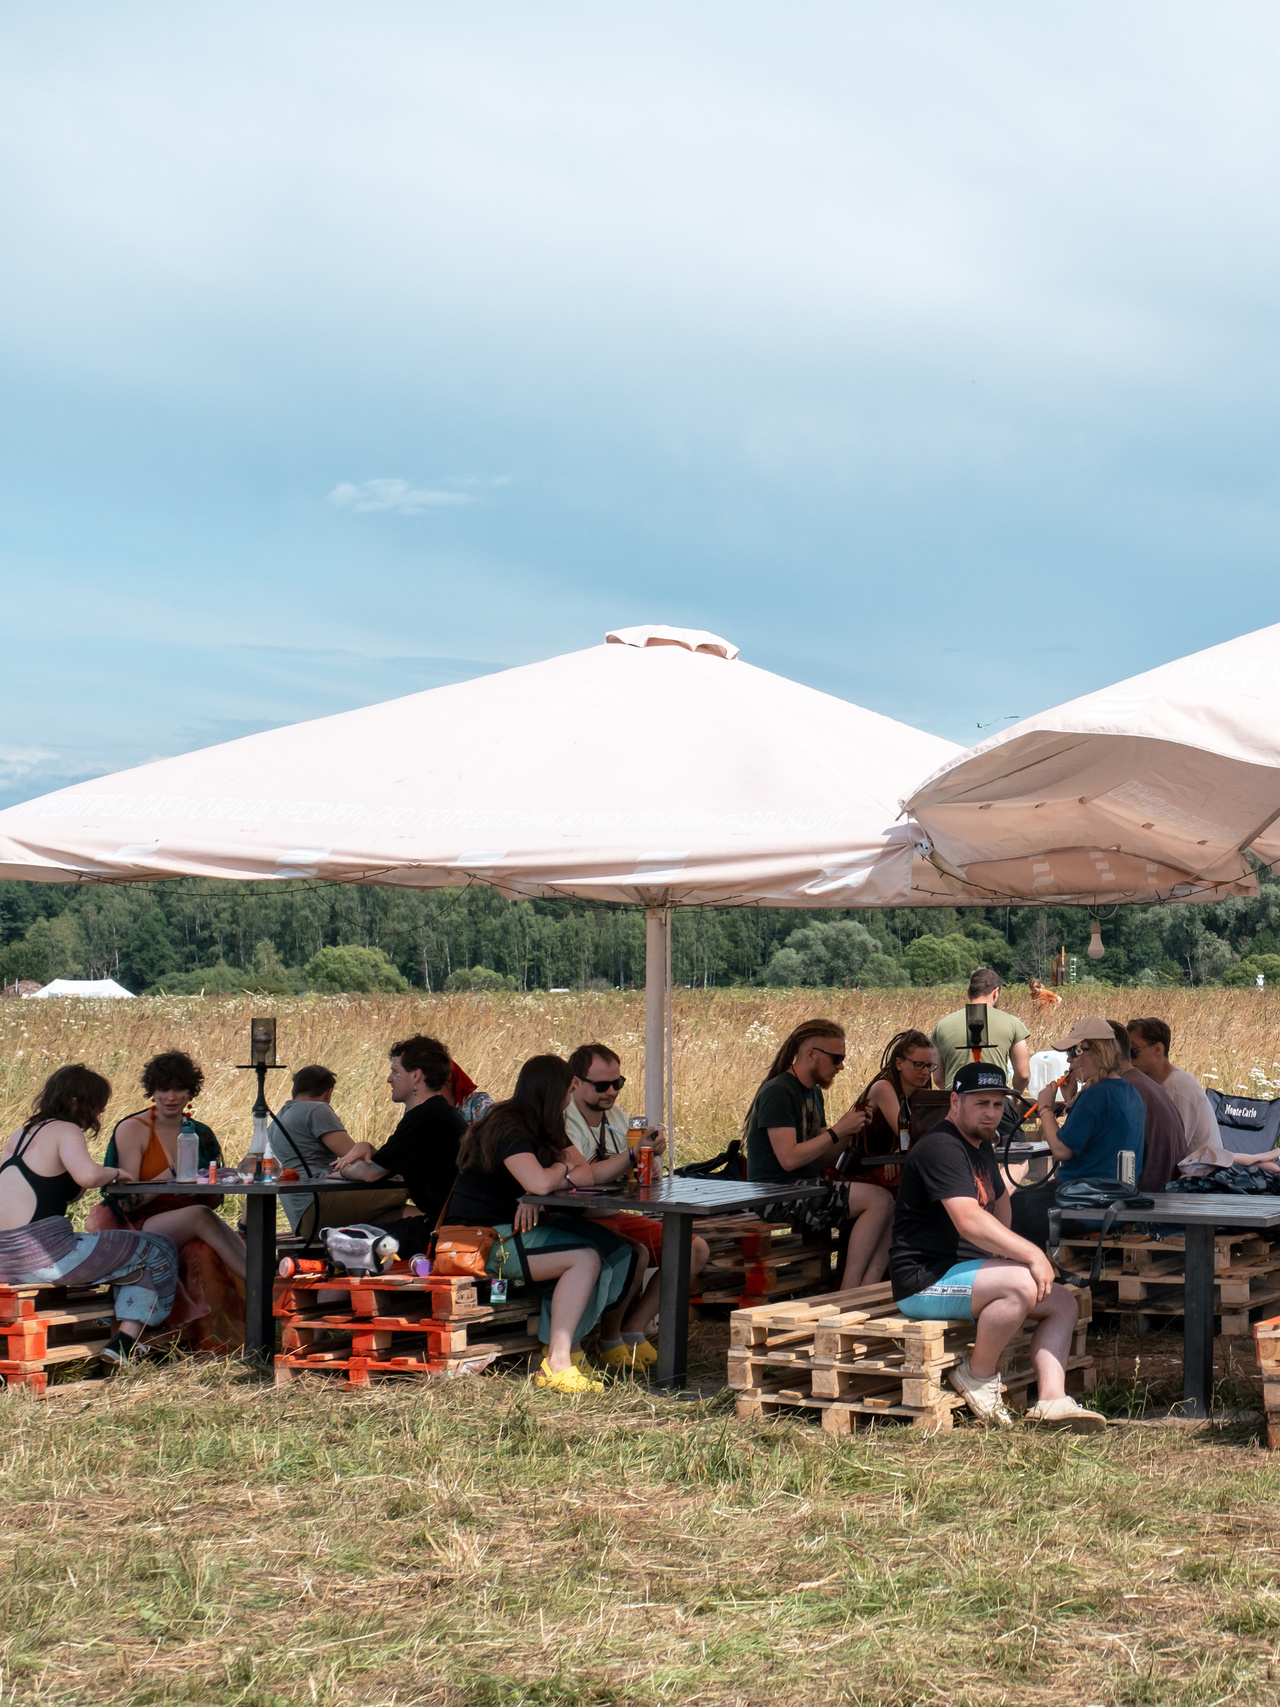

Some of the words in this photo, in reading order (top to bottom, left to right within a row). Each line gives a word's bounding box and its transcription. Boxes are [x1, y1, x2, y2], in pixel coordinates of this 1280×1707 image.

[1193, 656, 1268, 689] ВРЕДЕ
[1225, 1104, 1241, 1117] Monte
[1242, 1107, 1257, 1118] Carlo
